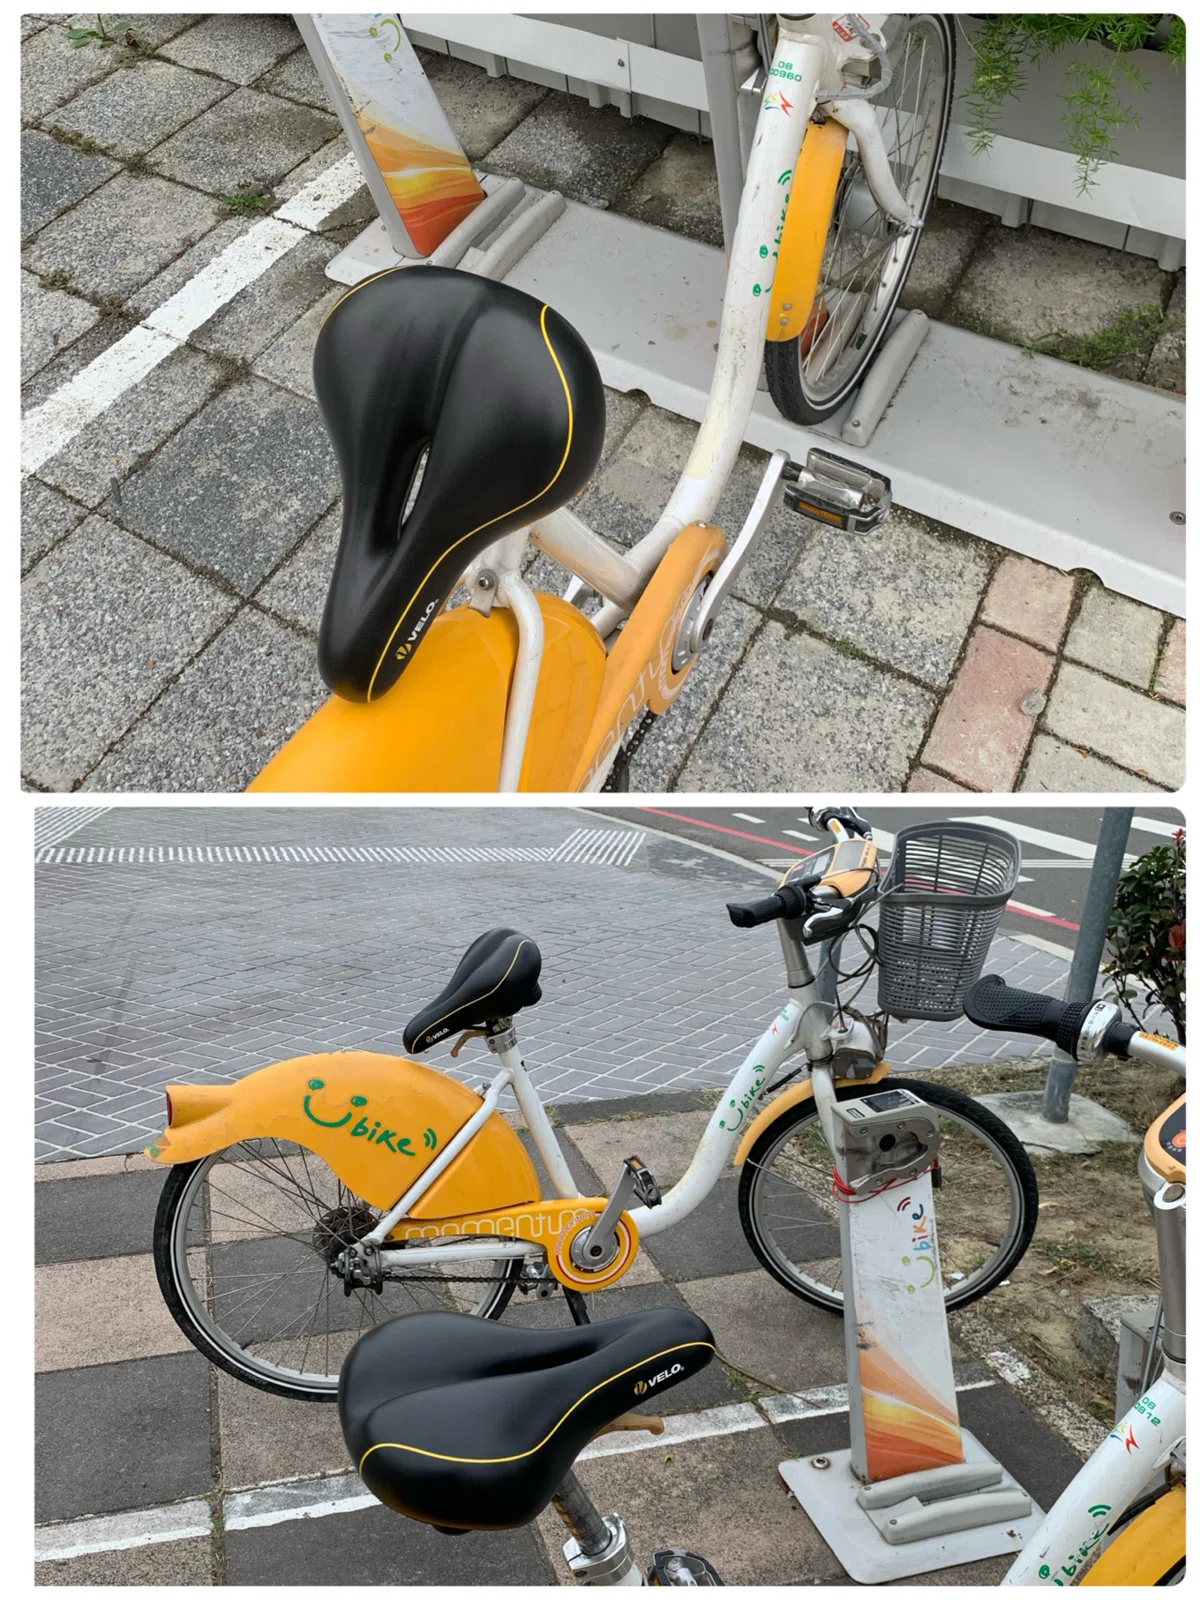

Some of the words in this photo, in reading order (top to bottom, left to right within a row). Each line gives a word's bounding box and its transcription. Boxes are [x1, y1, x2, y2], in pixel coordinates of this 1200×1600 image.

[778, 61, 793, 70] 06
[407, 601, 436, 641] VELO
[432, 1027, 449, 1040] VELO
[648, 1363, 682, 1388] VELO
[1141, 1396, 1156, 1410] 06
